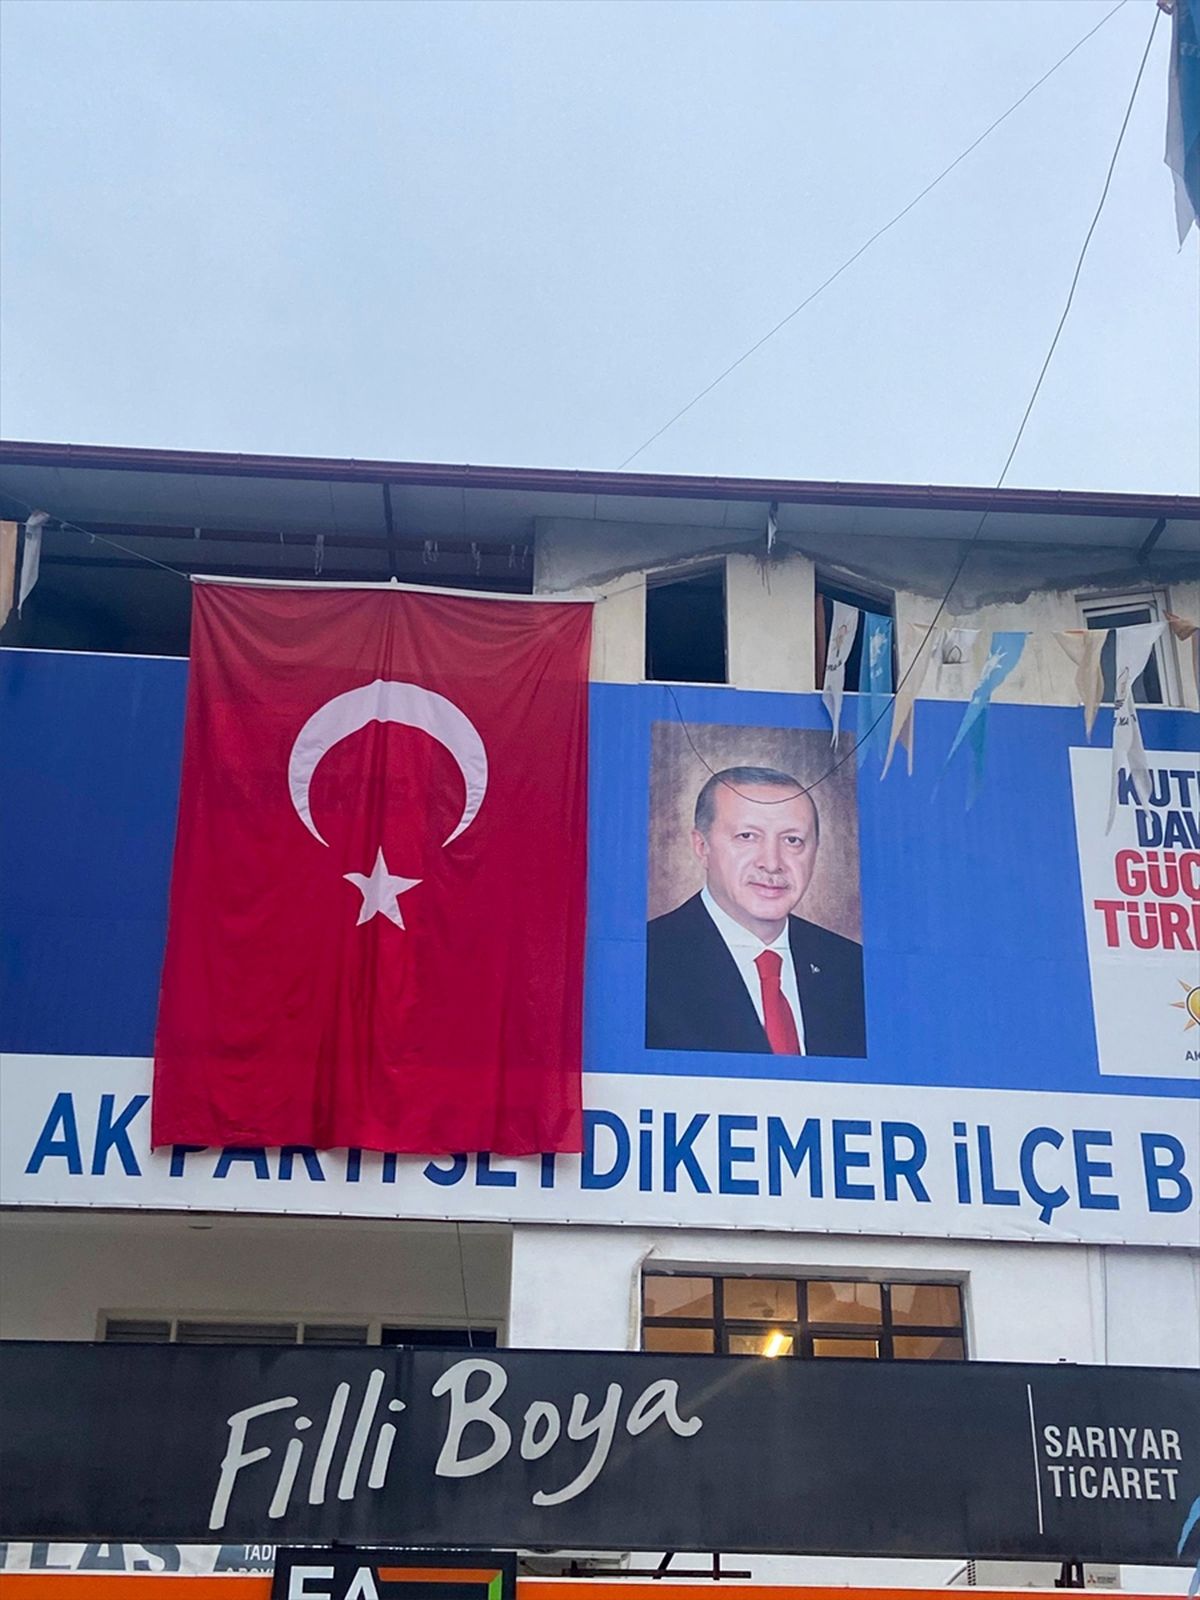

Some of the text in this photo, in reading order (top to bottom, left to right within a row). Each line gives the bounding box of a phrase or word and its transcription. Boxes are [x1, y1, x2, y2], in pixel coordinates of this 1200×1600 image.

[1118, 768, 1200, 808] KUT
[26, 1092, 150, 1176] AK
[208, 1358, 702, 1530] Filli Boya
[1044, 1425, 1182, 1461] SARIYAR
